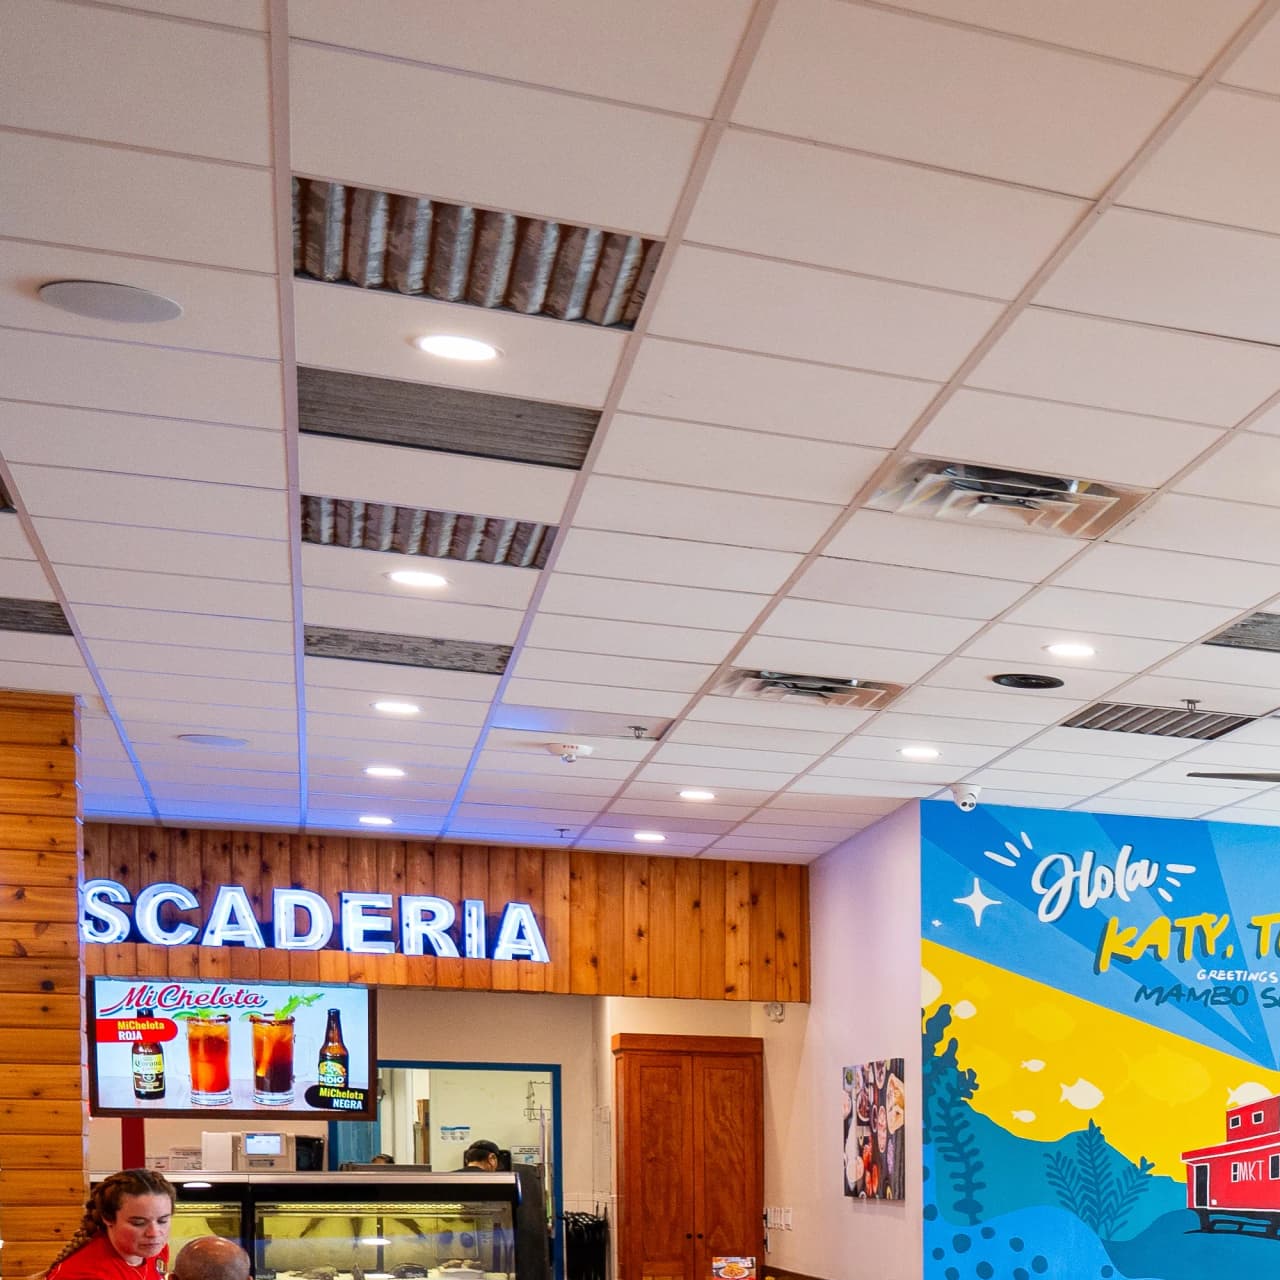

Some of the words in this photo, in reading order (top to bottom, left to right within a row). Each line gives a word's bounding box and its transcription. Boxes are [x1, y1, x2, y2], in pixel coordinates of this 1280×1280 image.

[1031, 844, 1159, 923] Hola
[80, 878, 551, 963] SCADERIA
[1196, 969, 1278, 984] GREETINGS
[100, 985, 267, 1016] MiChelota
[1134, 984, 1249, 1008] MAMBO
[117, 1021, 165, 1031] MiChelota
[118, 1031, 143, 1041] ROJA
[319, 1087, 364, 1100] MiChelota
[333, 1099, 363, 1110] NEGRA
